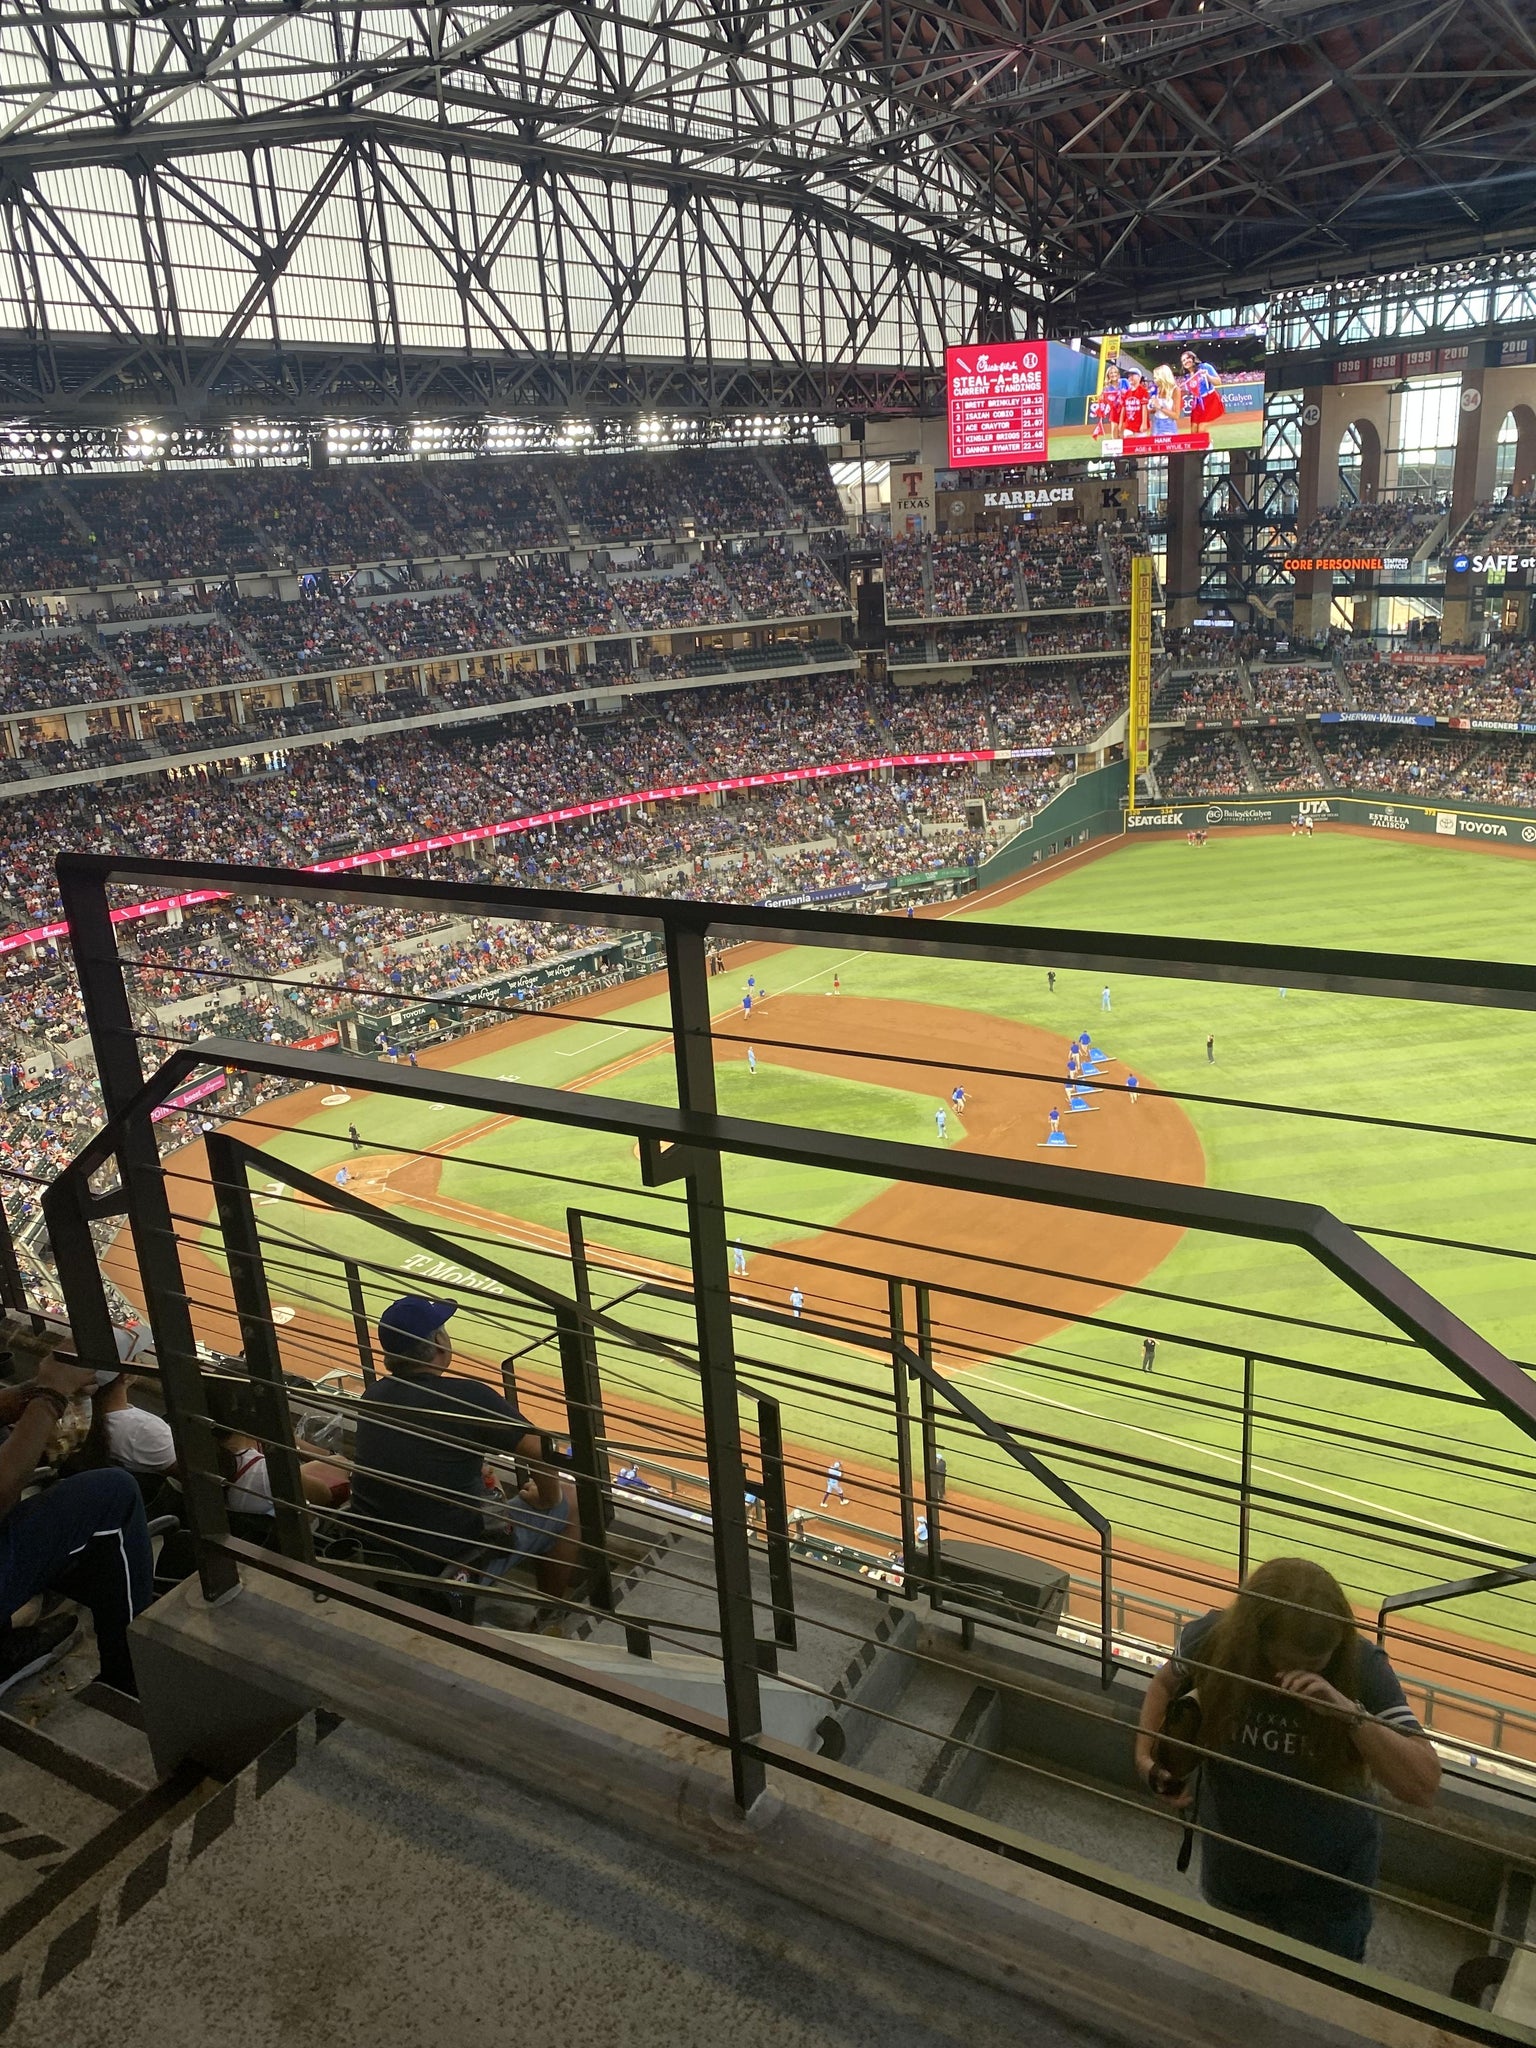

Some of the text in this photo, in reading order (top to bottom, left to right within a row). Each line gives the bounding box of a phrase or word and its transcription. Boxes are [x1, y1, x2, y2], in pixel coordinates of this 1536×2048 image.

[1444, 346, 1469, 359] 2010
[1502, 340, 1528, 353] 2010
[1372, 355, 1396, 368] 1998
[1406, 351, 1431, 364] 1999
[953, 371, 1041, 388] STEAL-A-BASE
[953, 382, 1041, 396] CURRENT STANDINGS
[1463, 394, 1479, 408] 34
[1305, 410, 1319, 421] 42
[984, 487, 1074, 507] KARBACH
[1101, 488, 1121, 507] K
[897, 499, 930, 510] TEXAS
[1284, 558, 1383, 570] CORE PERSONNEL
[1472, 555, 1536, 572] SAFE at
[1471, 720, 1519, 730] GARDENERS
[1299, 800, 1330, 814] UTA
[1128, 813, 1183, 828] SEATGEEK
[1368, 813, 1410, 825] ESTRELLA
[1371, 819, 1406, 830] JALISCO
[1459, 820, 1508, 837] TOYOTA
[765, 894, 811, 908] Germania
[555, 964, 575, 977] Kroger
[517, 975, 539, 989] Kroger
[478, 988, 500, 1001] Kroger
[402, 1008, 426, 1019] TOYOTA
